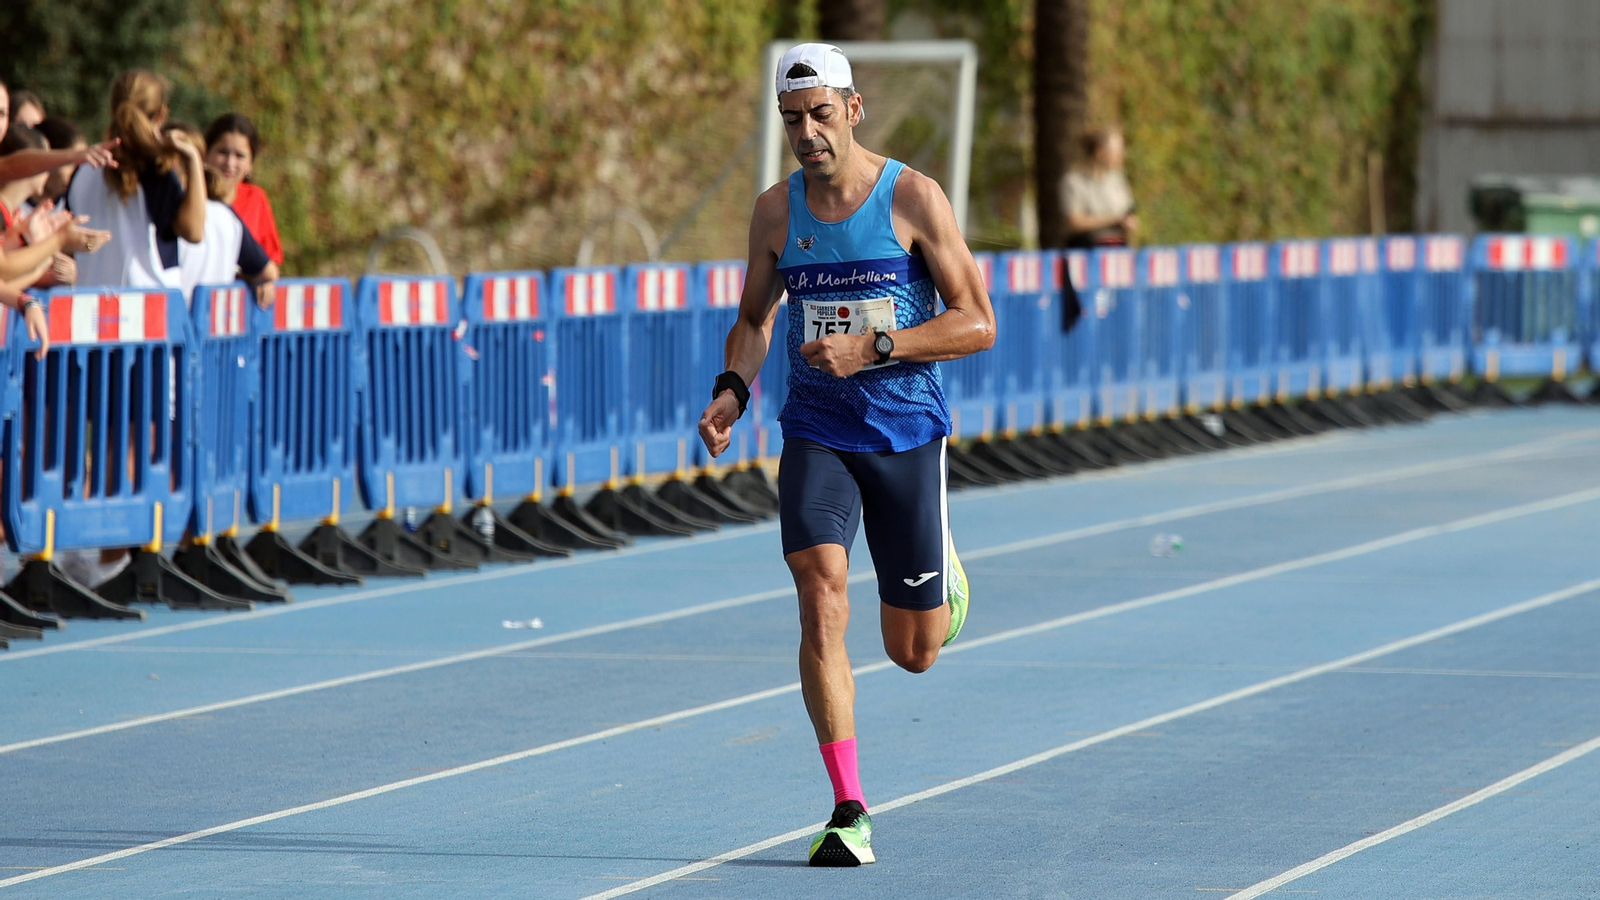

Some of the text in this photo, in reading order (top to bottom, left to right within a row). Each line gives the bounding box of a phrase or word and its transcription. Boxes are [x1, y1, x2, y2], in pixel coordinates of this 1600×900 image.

[788, 269, 897, 290] C.A. Montellano
[812, 321, 852, 340] 757
